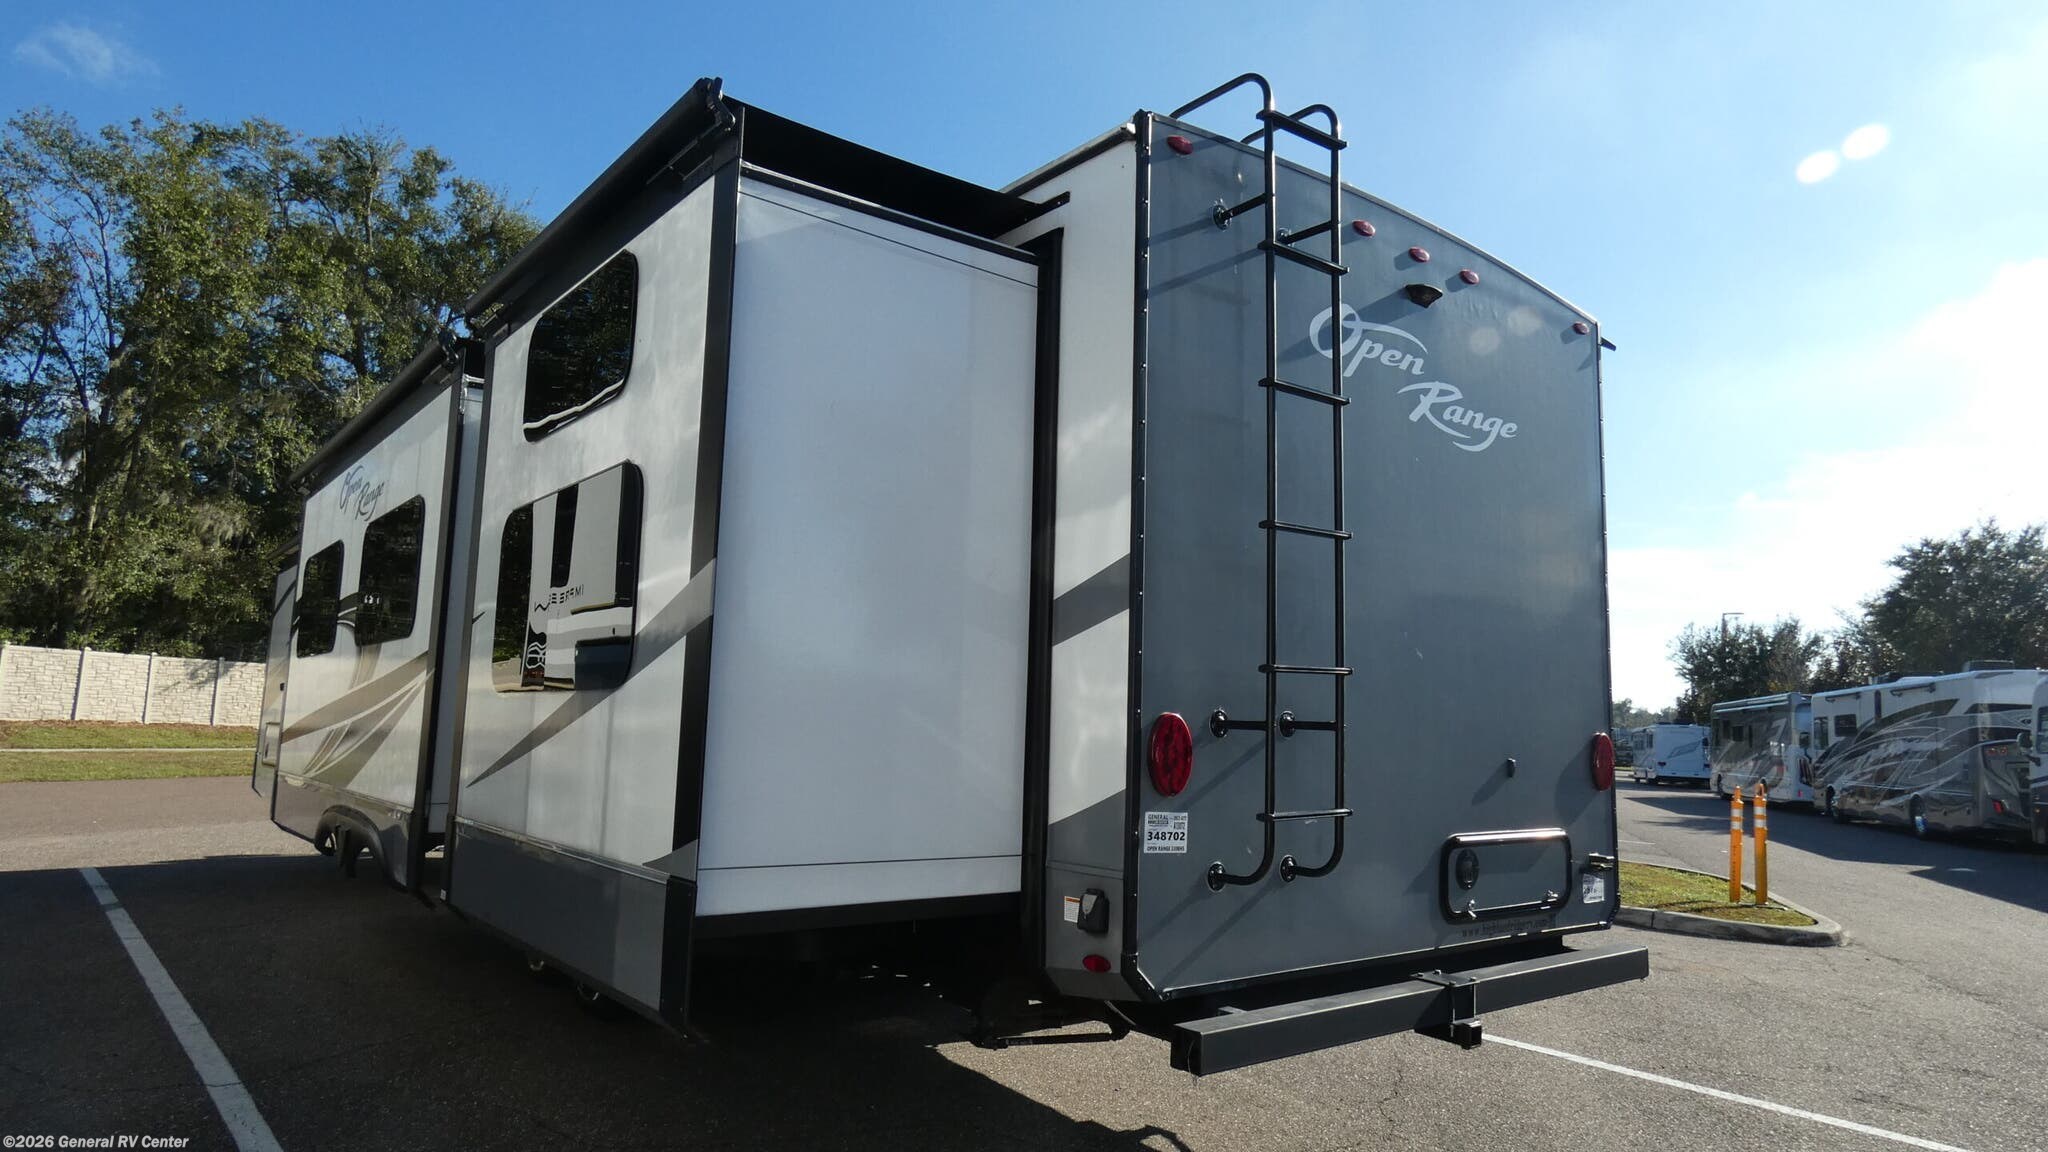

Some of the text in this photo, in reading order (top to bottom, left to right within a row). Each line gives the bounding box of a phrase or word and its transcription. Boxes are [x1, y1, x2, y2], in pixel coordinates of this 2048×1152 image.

[1309, 303, 1428, 377] Open
[1397, 381, 1518, 452] Range
[339, 465, 364, 514] Open
[354, 481, 385, 521] Range
[1147, 831, 1185, 841] 348702
